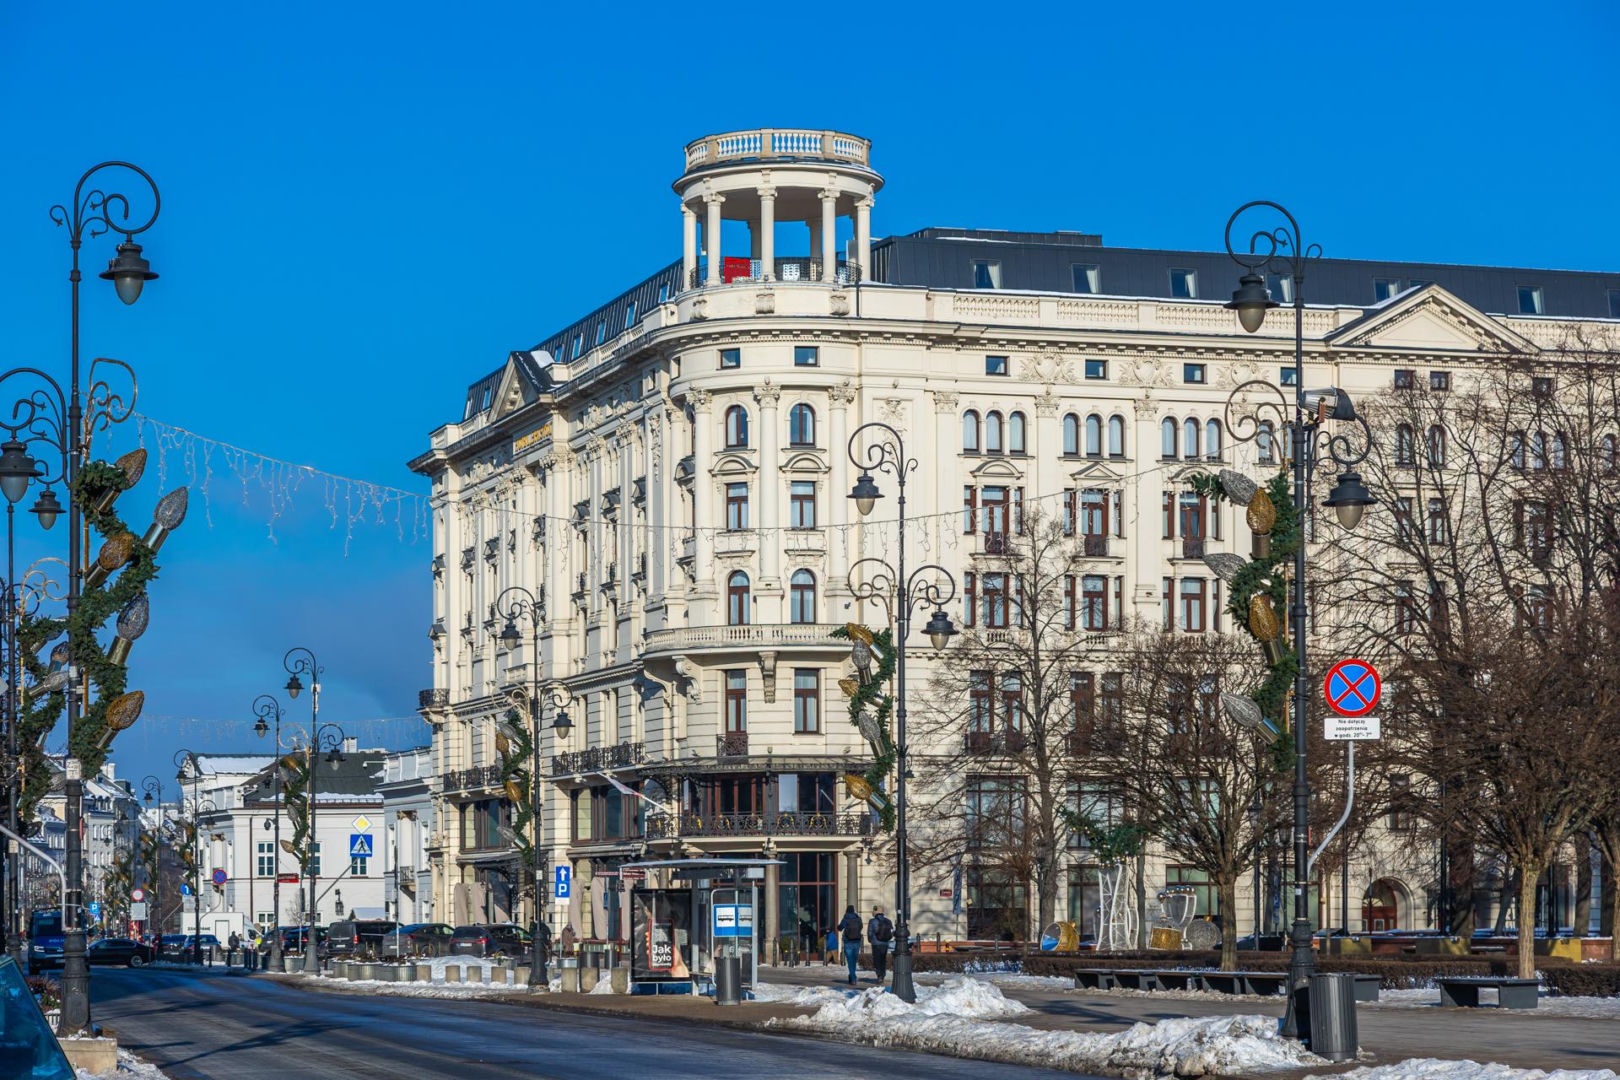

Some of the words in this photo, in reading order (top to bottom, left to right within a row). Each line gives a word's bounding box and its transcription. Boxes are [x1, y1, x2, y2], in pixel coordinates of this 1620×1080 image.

[558, 884, 566, 896] P
[652, 944, 671, 954] Jak
[652, 954, 672, 963] było
